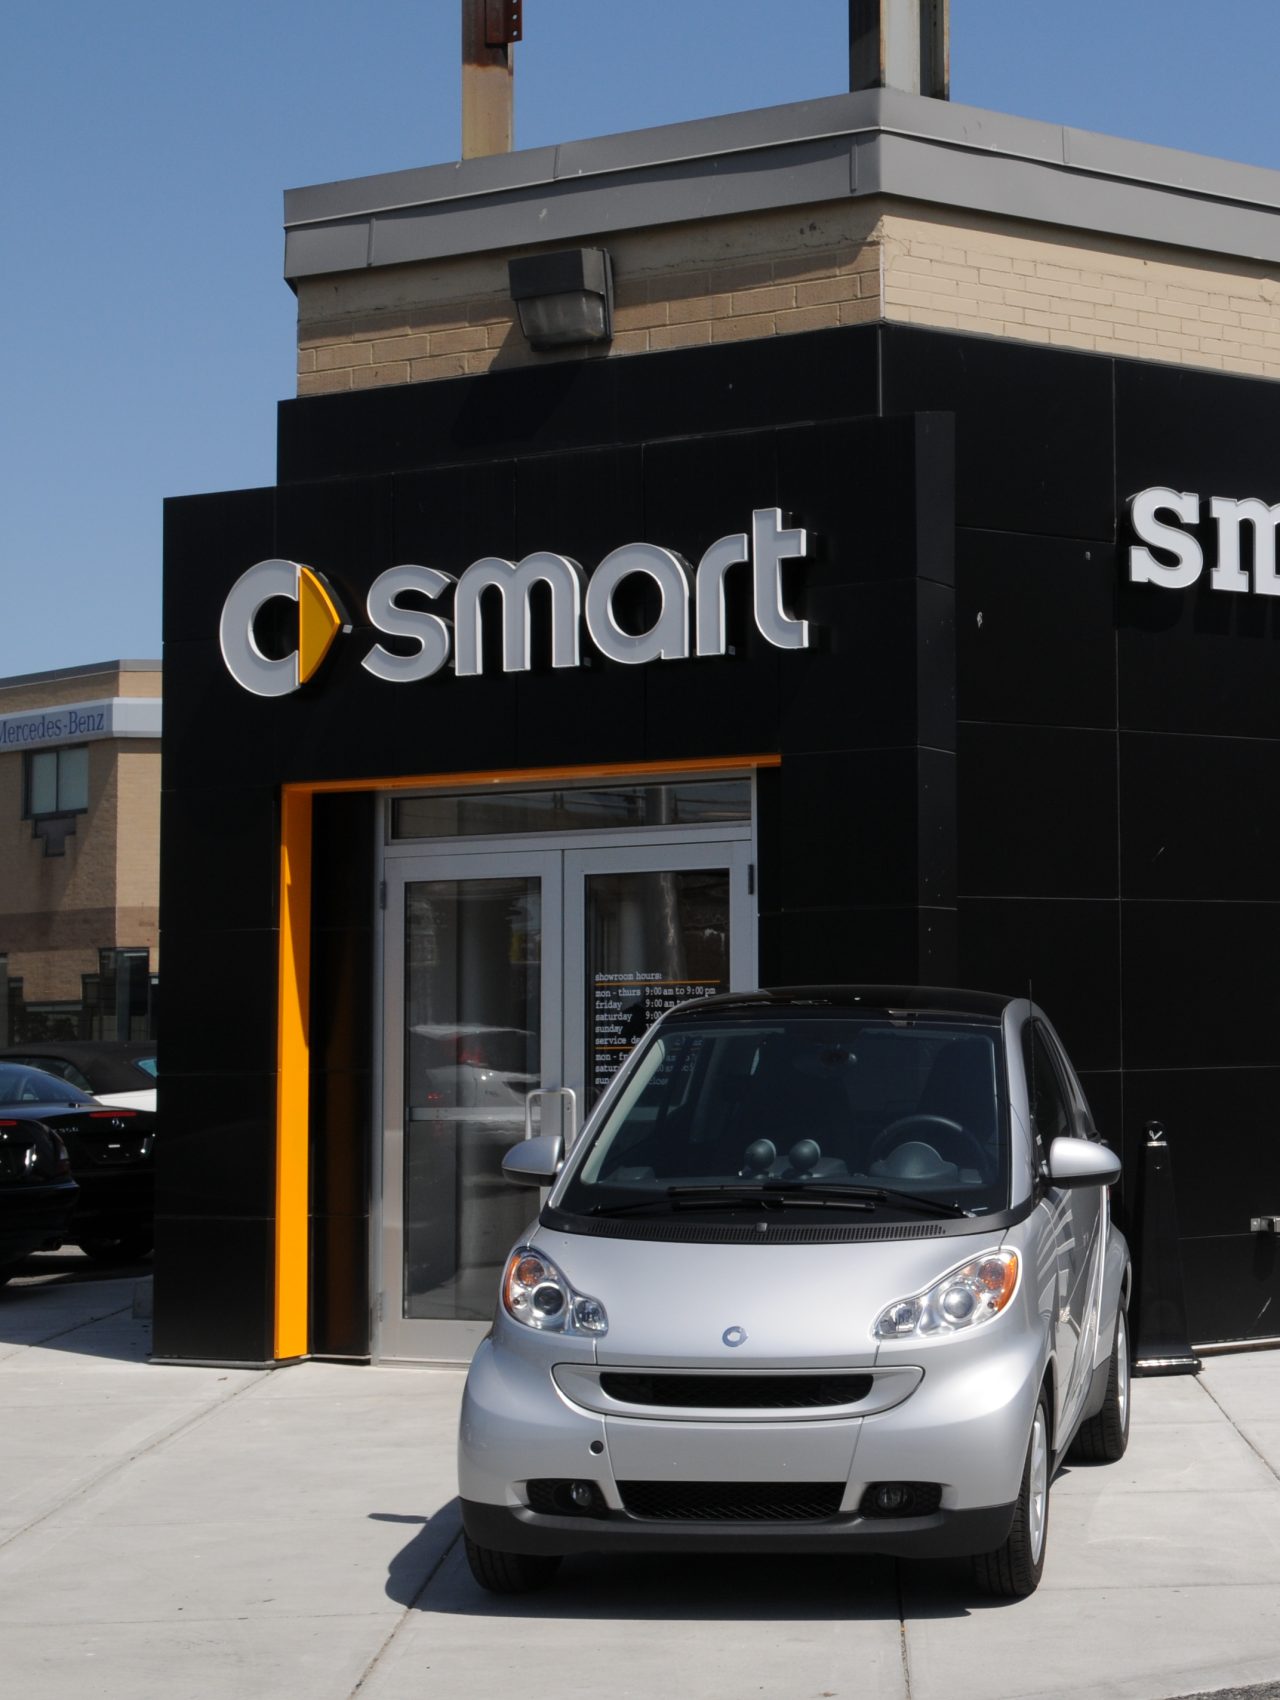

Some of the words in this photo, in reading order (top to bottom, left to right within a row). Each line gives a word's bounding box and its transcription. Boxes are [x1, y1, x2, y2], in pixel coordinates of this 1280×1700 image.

[360, 507, 809, 683] smart
[595, 972, 634, 982] showroom
[635, 971, 662, 981] hours:
[618, 987, 641, 997] thurs
[645, 986, 662, 996] 9:00
[675, 987, 685, 995] to
[686, 985, 704, 995] 9:00
[705, 987, 716, 997] pm
[595, 1000, 623, 1010] friday
[645, 998, 663, 1008] 9:00
[595, 1012, 632, 1022] saturday
[595, 1024, 623, 1034] sunday
[595, 1036, 627, 1044] service
[595, 1053, 611, 1061] mon
